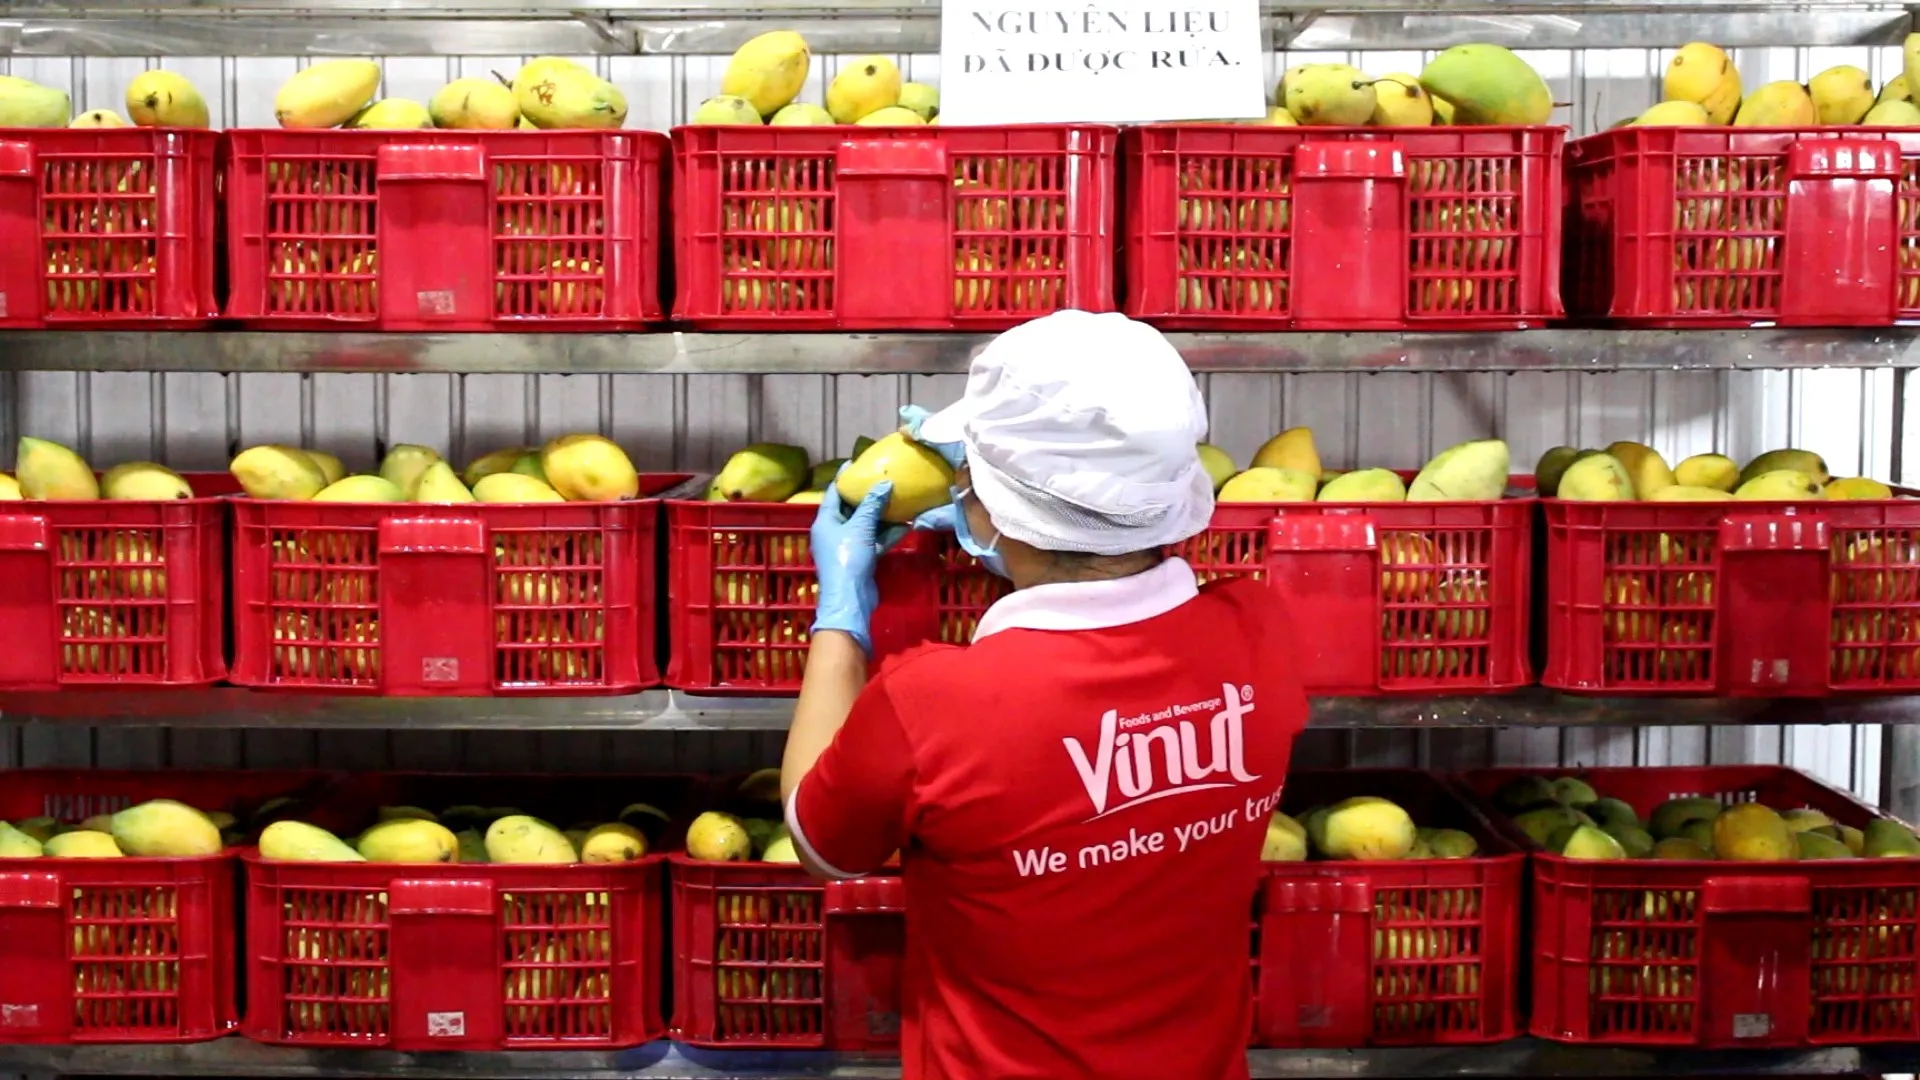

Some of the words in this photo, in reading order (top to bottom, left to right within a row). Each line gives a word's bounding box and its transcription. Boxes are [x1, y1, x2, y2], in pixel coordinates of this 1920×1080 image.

[970, 3, 1128, 34] NGUYÊN
[1143, 10, 1231, 38] LIỆU
[1119, 713, 1151, 729] Foods
[1152, 706, 1172, 721] and
[1173, 698, 1221, 716] Beverage
[1062, 682, 1262, 814] Vinut
[1013, 847, 1067, 877] We
[1078, 828, 1164, 869] make
[1173, 808, 1239, 852] your
[1245, 785, 1284, 822] trus
